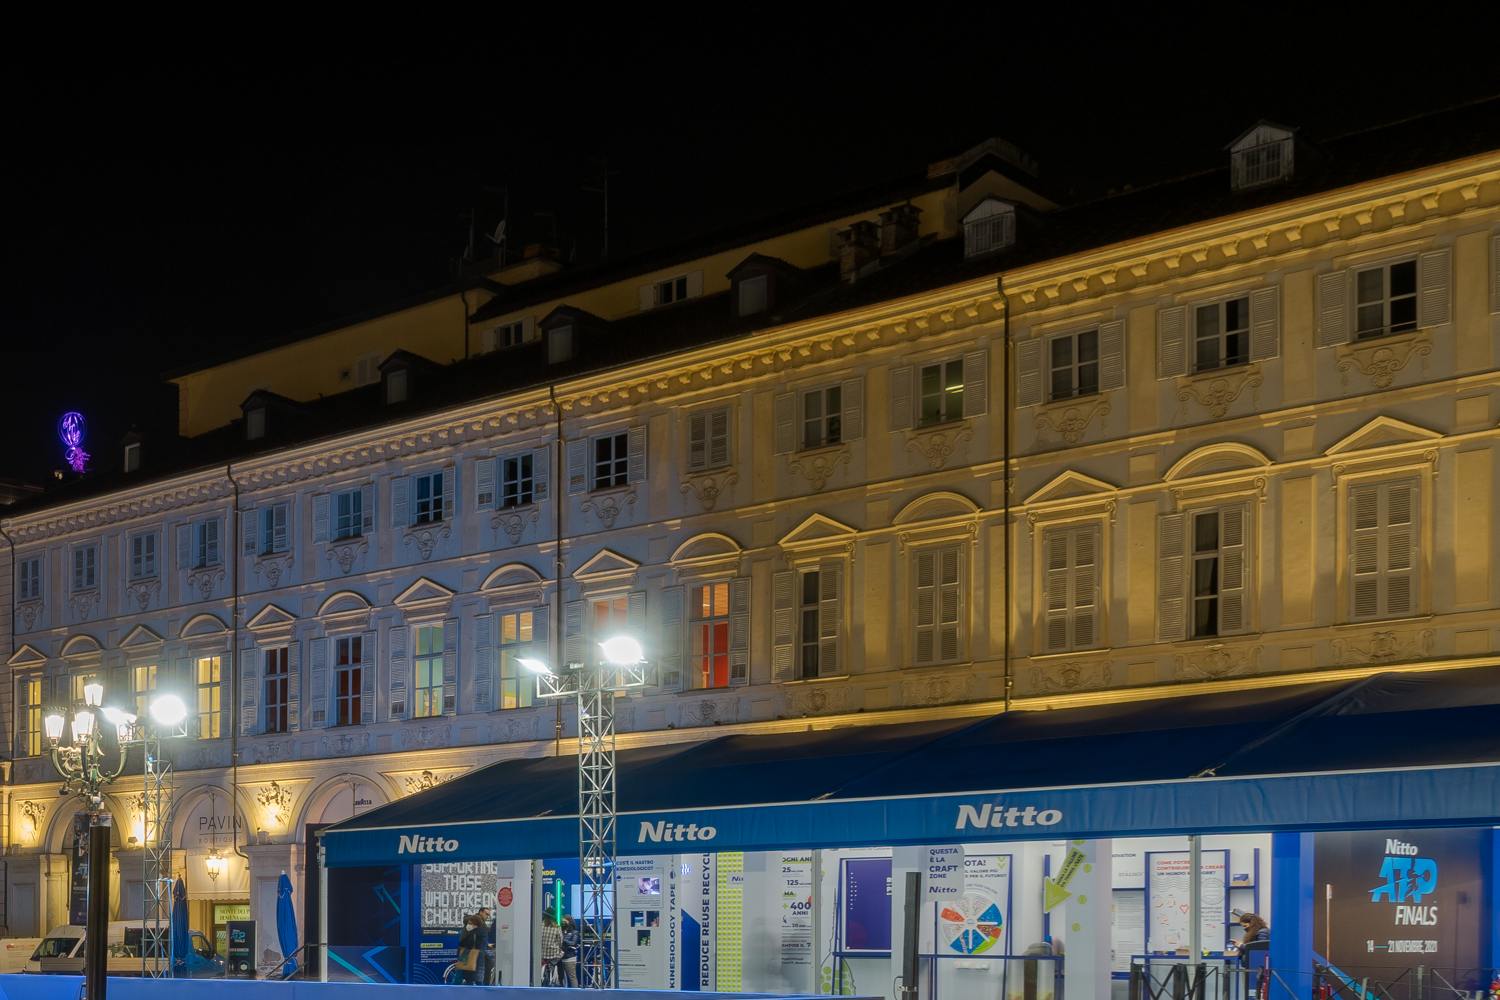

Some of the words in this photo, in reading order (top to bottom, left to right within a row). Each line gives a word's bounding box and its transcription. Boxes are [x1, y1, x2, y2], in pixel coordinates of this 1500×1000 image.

[200, 816, 241, 830] PAVIN
[955, 804, 1062, 829] Nitto
[638, 821, 717, 843] Nitto
[398, 834, 459, 854] Nitto
[1385, 839, 1418, 855] Nitto
[75, 866, 88, 875] AT
[425, 862, 498, 874] SUPPORTING
[443, 875, 482, 891] THOSE
[1368, 856, 1438, 903] ATP
[425, 891, 449, 907] WHO
[450, 892, 482, 908] TAKE
[482, 892, 498, 908] ON
[702, 899, 710, 936] REUSE
[1395, 906, 1438, 925] FINALS
[1367, 940, 1374, 952] 14
[1388, 940, 1394, 952] 21
[1395, 940, 1424, 954] NOVEMBRE,
[1425, 941, 1437, 952] 2021
